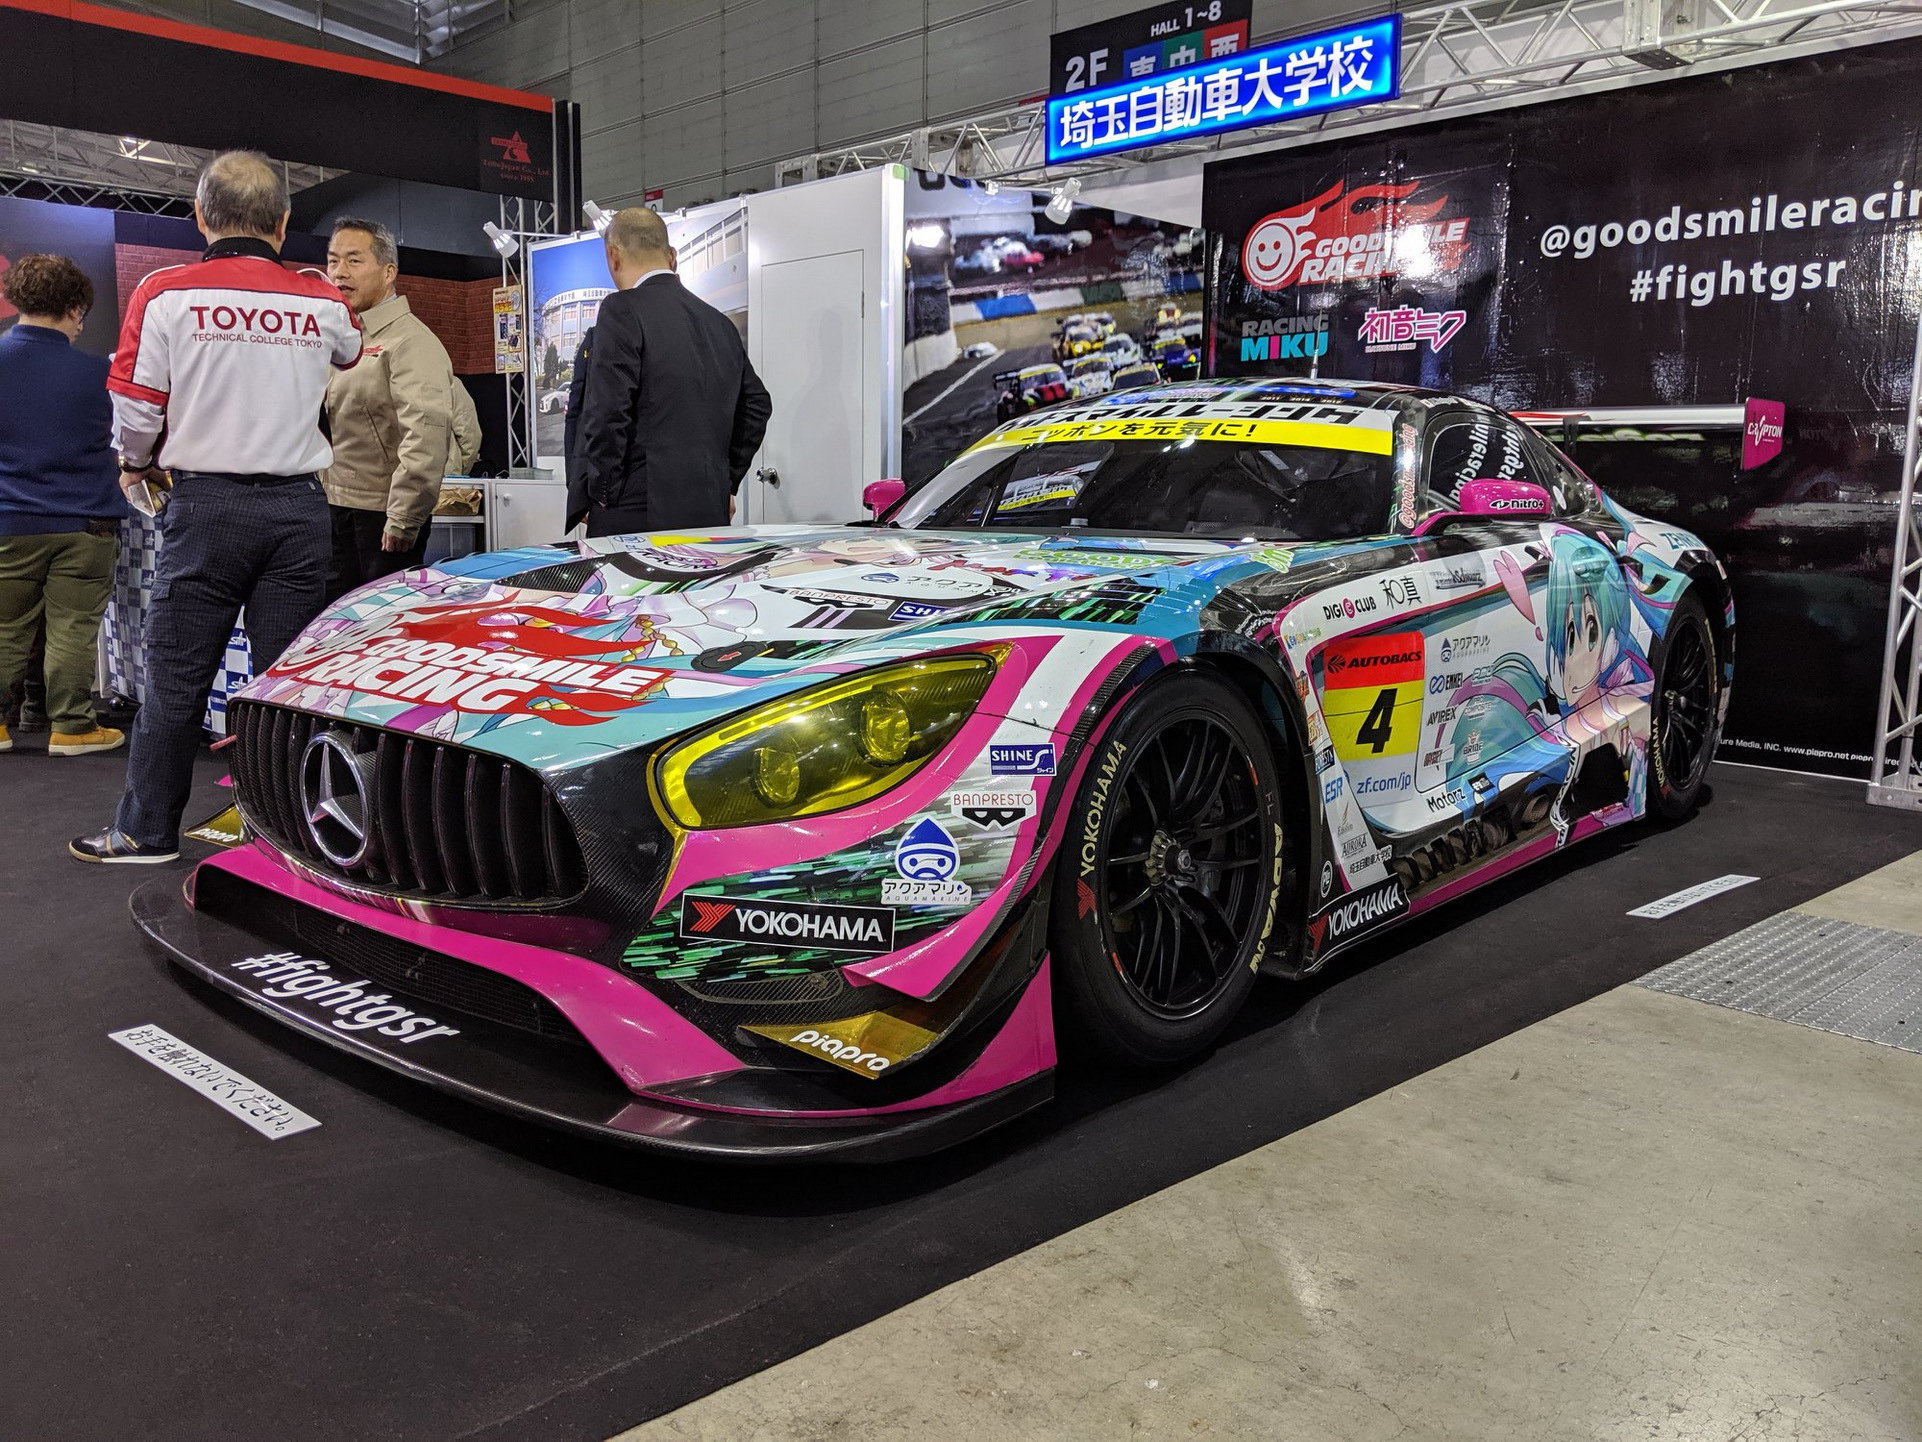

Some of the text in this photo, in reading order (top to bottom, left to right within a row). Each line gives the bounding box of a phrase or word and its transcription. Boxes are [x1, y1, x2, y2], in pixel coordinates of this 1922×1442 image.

[1150, 18, 1180, 38] HALL
[1064, 48, 1110, 94] 2F
[1060, 35, 1375, 149] 埼玉自動車大学校
[1630, 259, 1847, 307] #fightgsr
[190, 305, 322, 338] TOYOTA
[1242, 315, 1330, 338] RACING
[1358, 305, 1467, 353] 初音ミク
[192, 332, 323, 349] TECHNICAL COLLEGE TOKYO
[1240, 331, 1330, 362] MIKU
[787, 588, 890, 606] BANPRESTO
[1323, 605, 1345, 620] DIGI
[1355, 596, 1377, 614] CLUB
[1452, 635, 1491, 652] アクアマリン
[374, 638, 664, 694] GOODSMILE
[1347, 650, 1422, 669] AUTOBACS
[300, 653, 540, 711] RACING
[1356, 688, 1398, 754] 4
[1427, 707, 1457, 727] AVIREX
[1463, 740, 1483, 755] BRIDE
[1652, 716, 1666, 788] YOKOHAMA
[1735, 739, 1762, 750] Media,
[1763, 743, 1782, 752] INC.
[1783, 745, 1850, 761] www.piapro.net
[1850, 754, 1874, 762] piapr
[1325, 776, 1344, 804] ESR
[1356, 772, 1412, 795] zf.com/jp
[953, 792, 1034, 807] BANPRESTO
[1080, 740, 1127, 877] YOKOHAMA
[1427, 788, 1466, 813] Motorz
[884, 882, 969, 896] アクアマリン
[735, 908, 886, 943] YOKOHAMA
[1328, 882, 1404, 940] YOKOHAMA
[231, 952, 461, 1044] #fightgsr
[789, 1030, 890, 1071] piapro
